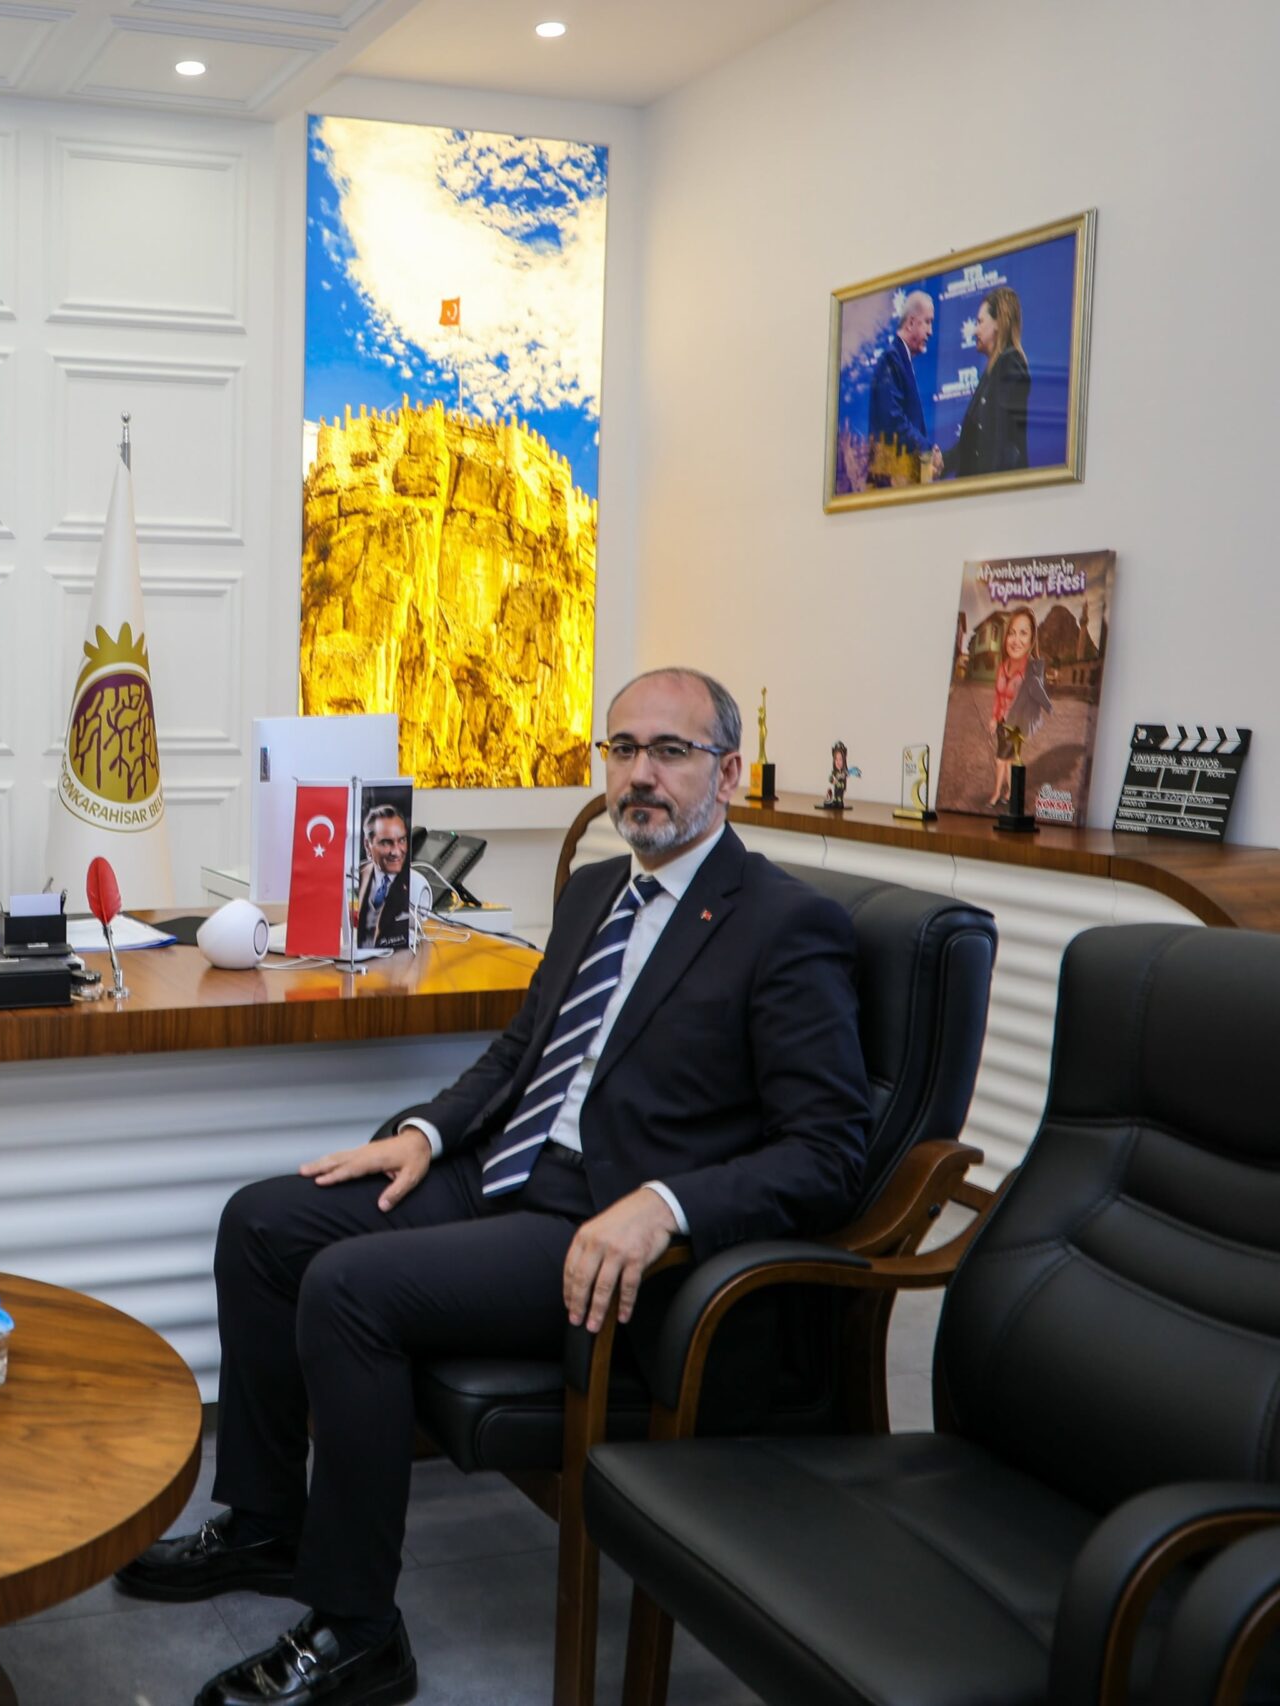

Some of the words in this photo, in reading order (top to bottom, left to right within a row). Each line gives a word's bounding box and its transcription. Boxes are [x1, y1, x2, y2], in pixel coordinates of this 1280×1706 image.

[990, 574, 1043, 603] Topuklu
[1047, 571, 1085, 595] Efesi
[1133, 754, 1179, 766] UNIVERSAL
